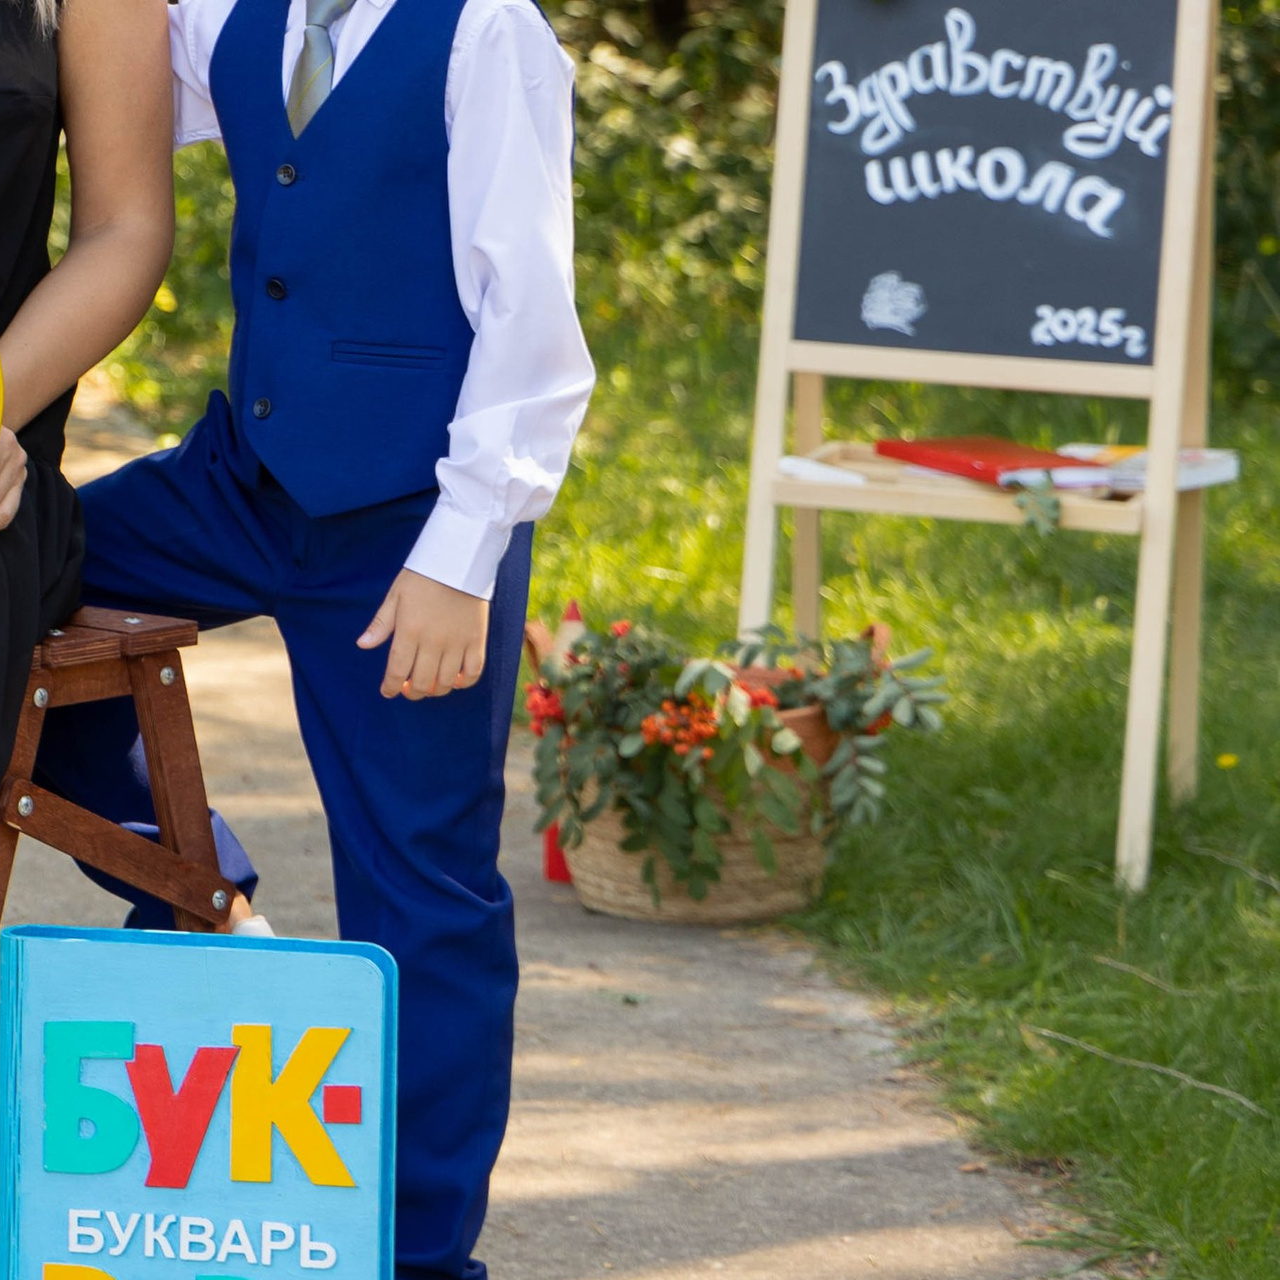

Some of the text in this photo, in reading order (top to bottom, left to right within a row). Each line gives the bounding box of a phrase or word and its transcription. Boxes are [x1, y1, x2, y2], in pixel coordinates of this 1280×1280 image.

[816, 7, 1176, 157] Здравствуй
[865, 145, 1126, 239] школа
[43, 1020, 362, 1189] БУК-
[68, 1209, 337, 1269] БУКВАРЬ
